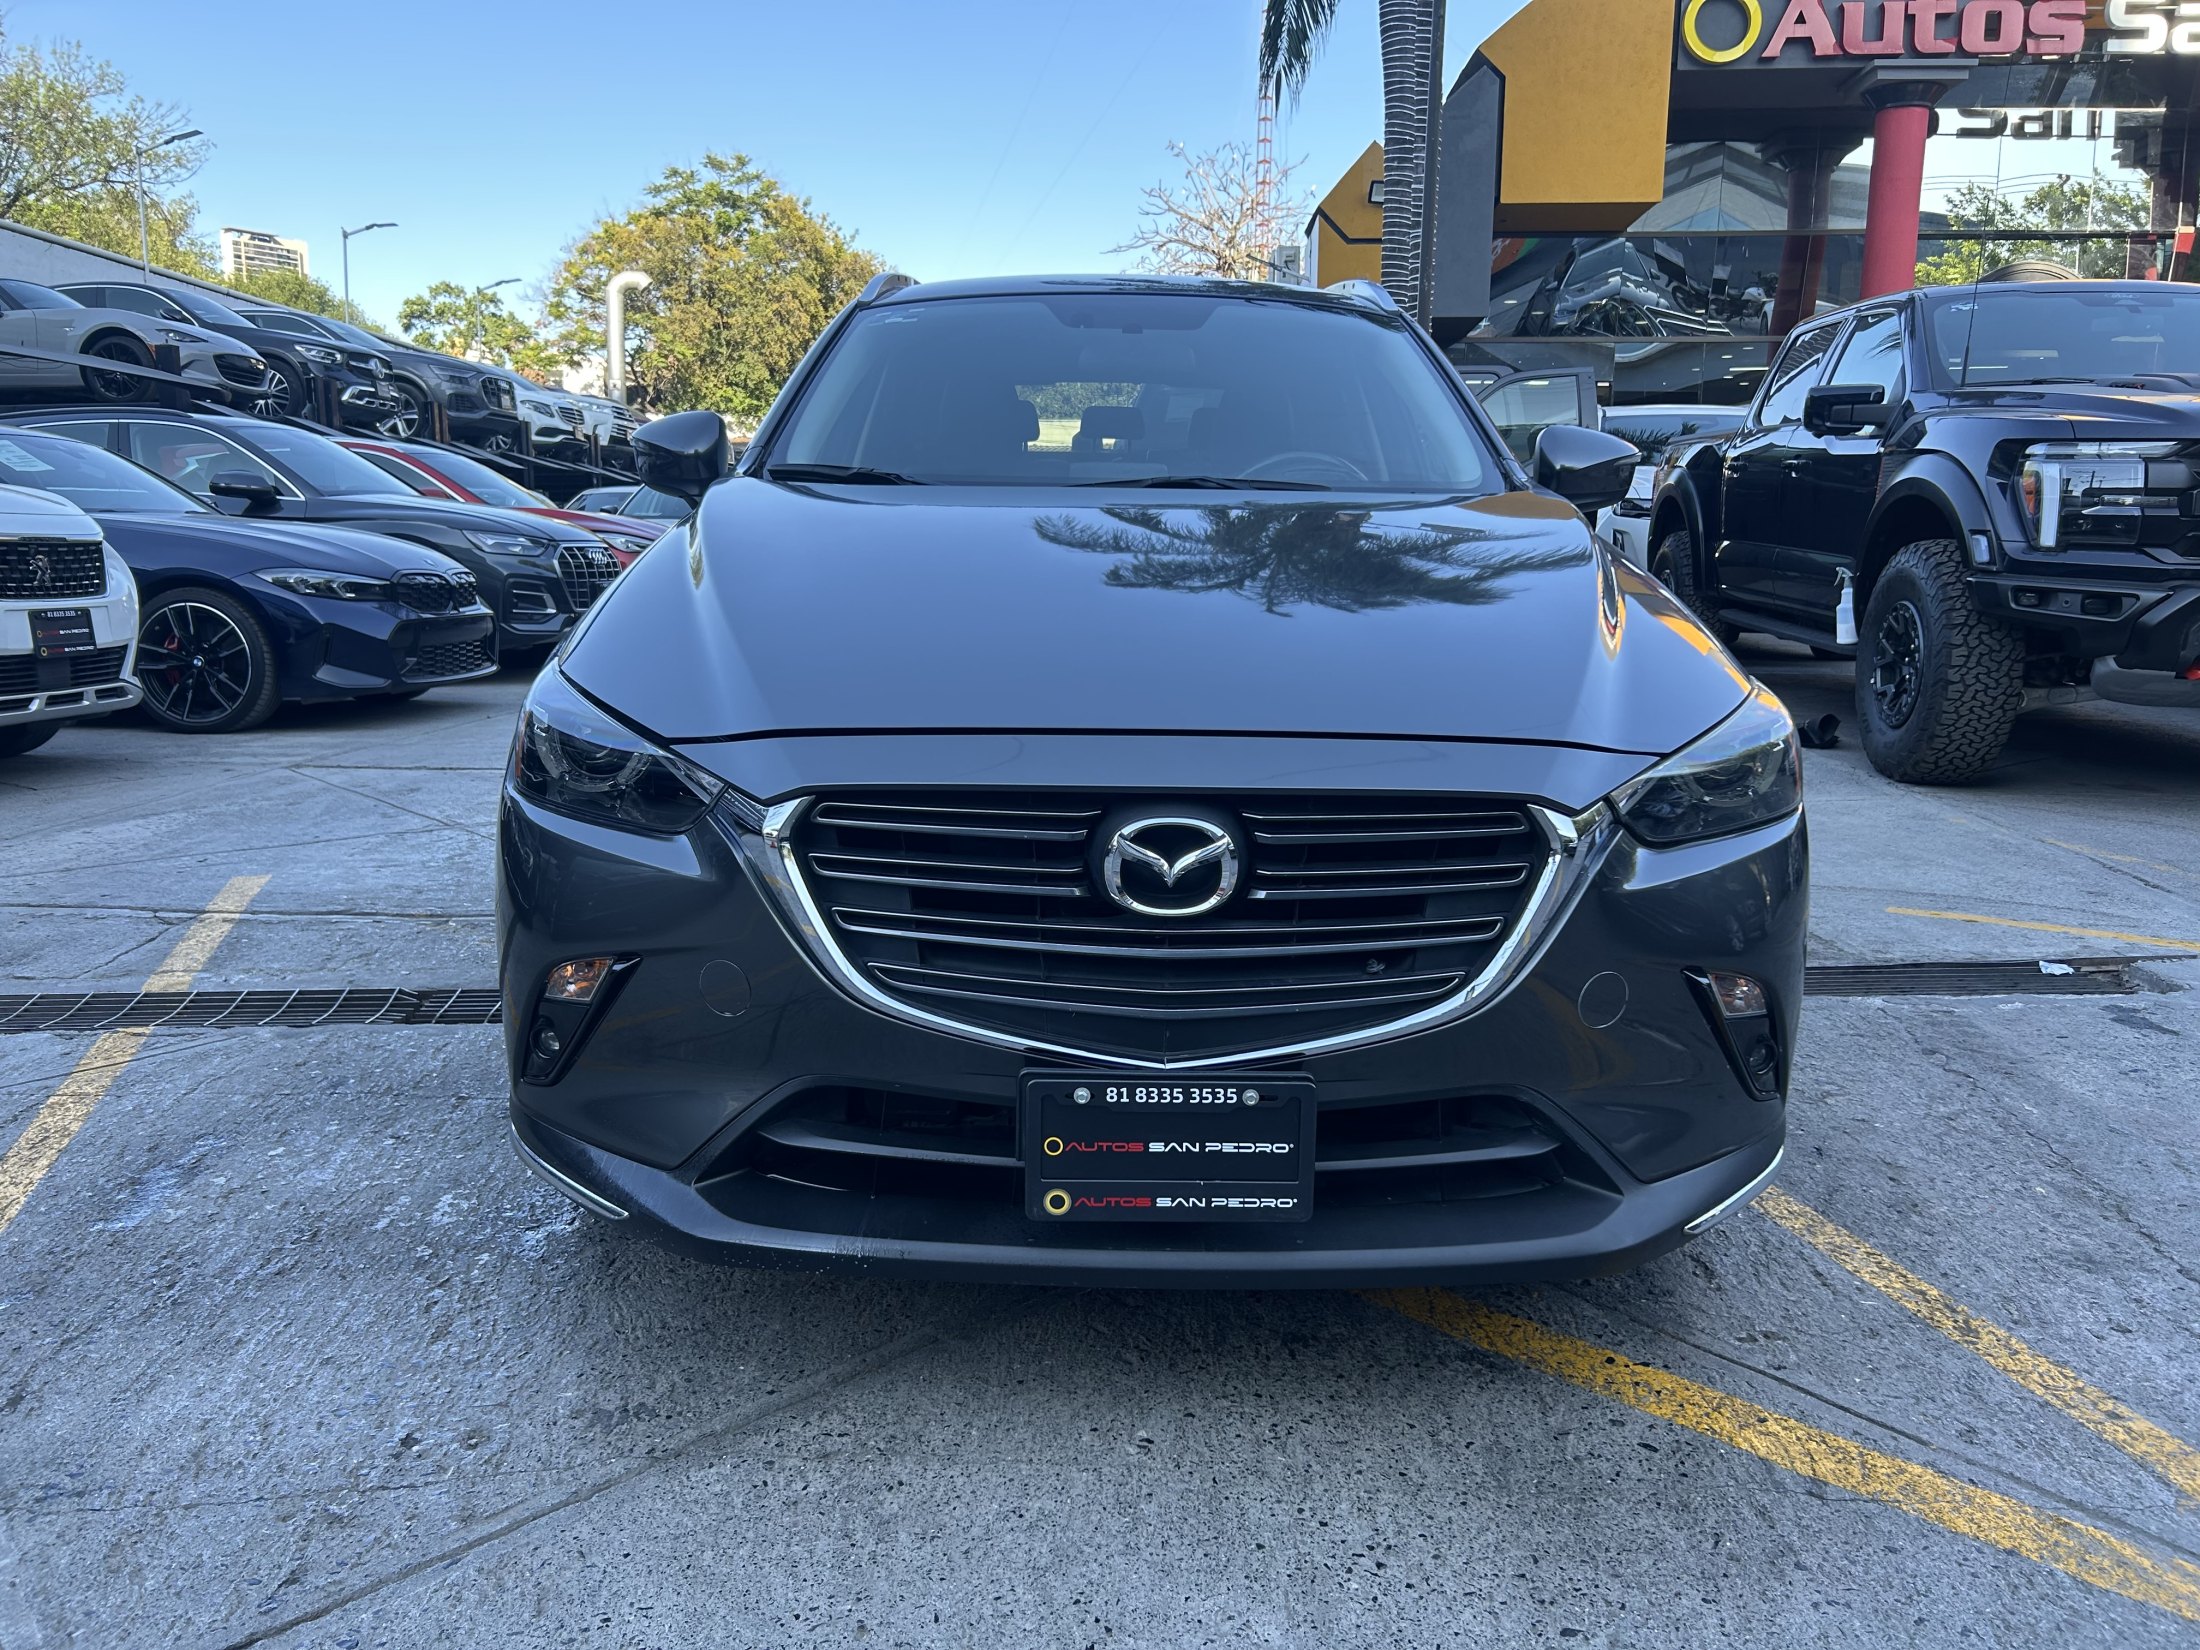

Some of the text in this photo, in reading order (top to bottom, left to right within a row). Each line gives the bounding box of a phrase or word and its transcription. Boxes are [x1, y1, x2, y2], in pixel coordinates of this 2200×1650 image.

[1761, 0, 2087, 58] Autos
[1106, 1087, 1237, 1104] 81 8335 3535
[1065, 1142, 1144, 1152] AUTOS
[1148, 1142, 1200, 1152] SAN
[1074, 1197, 1152, 1207] AUTOS
[1156, 1197, 1206, 1207] SAN
